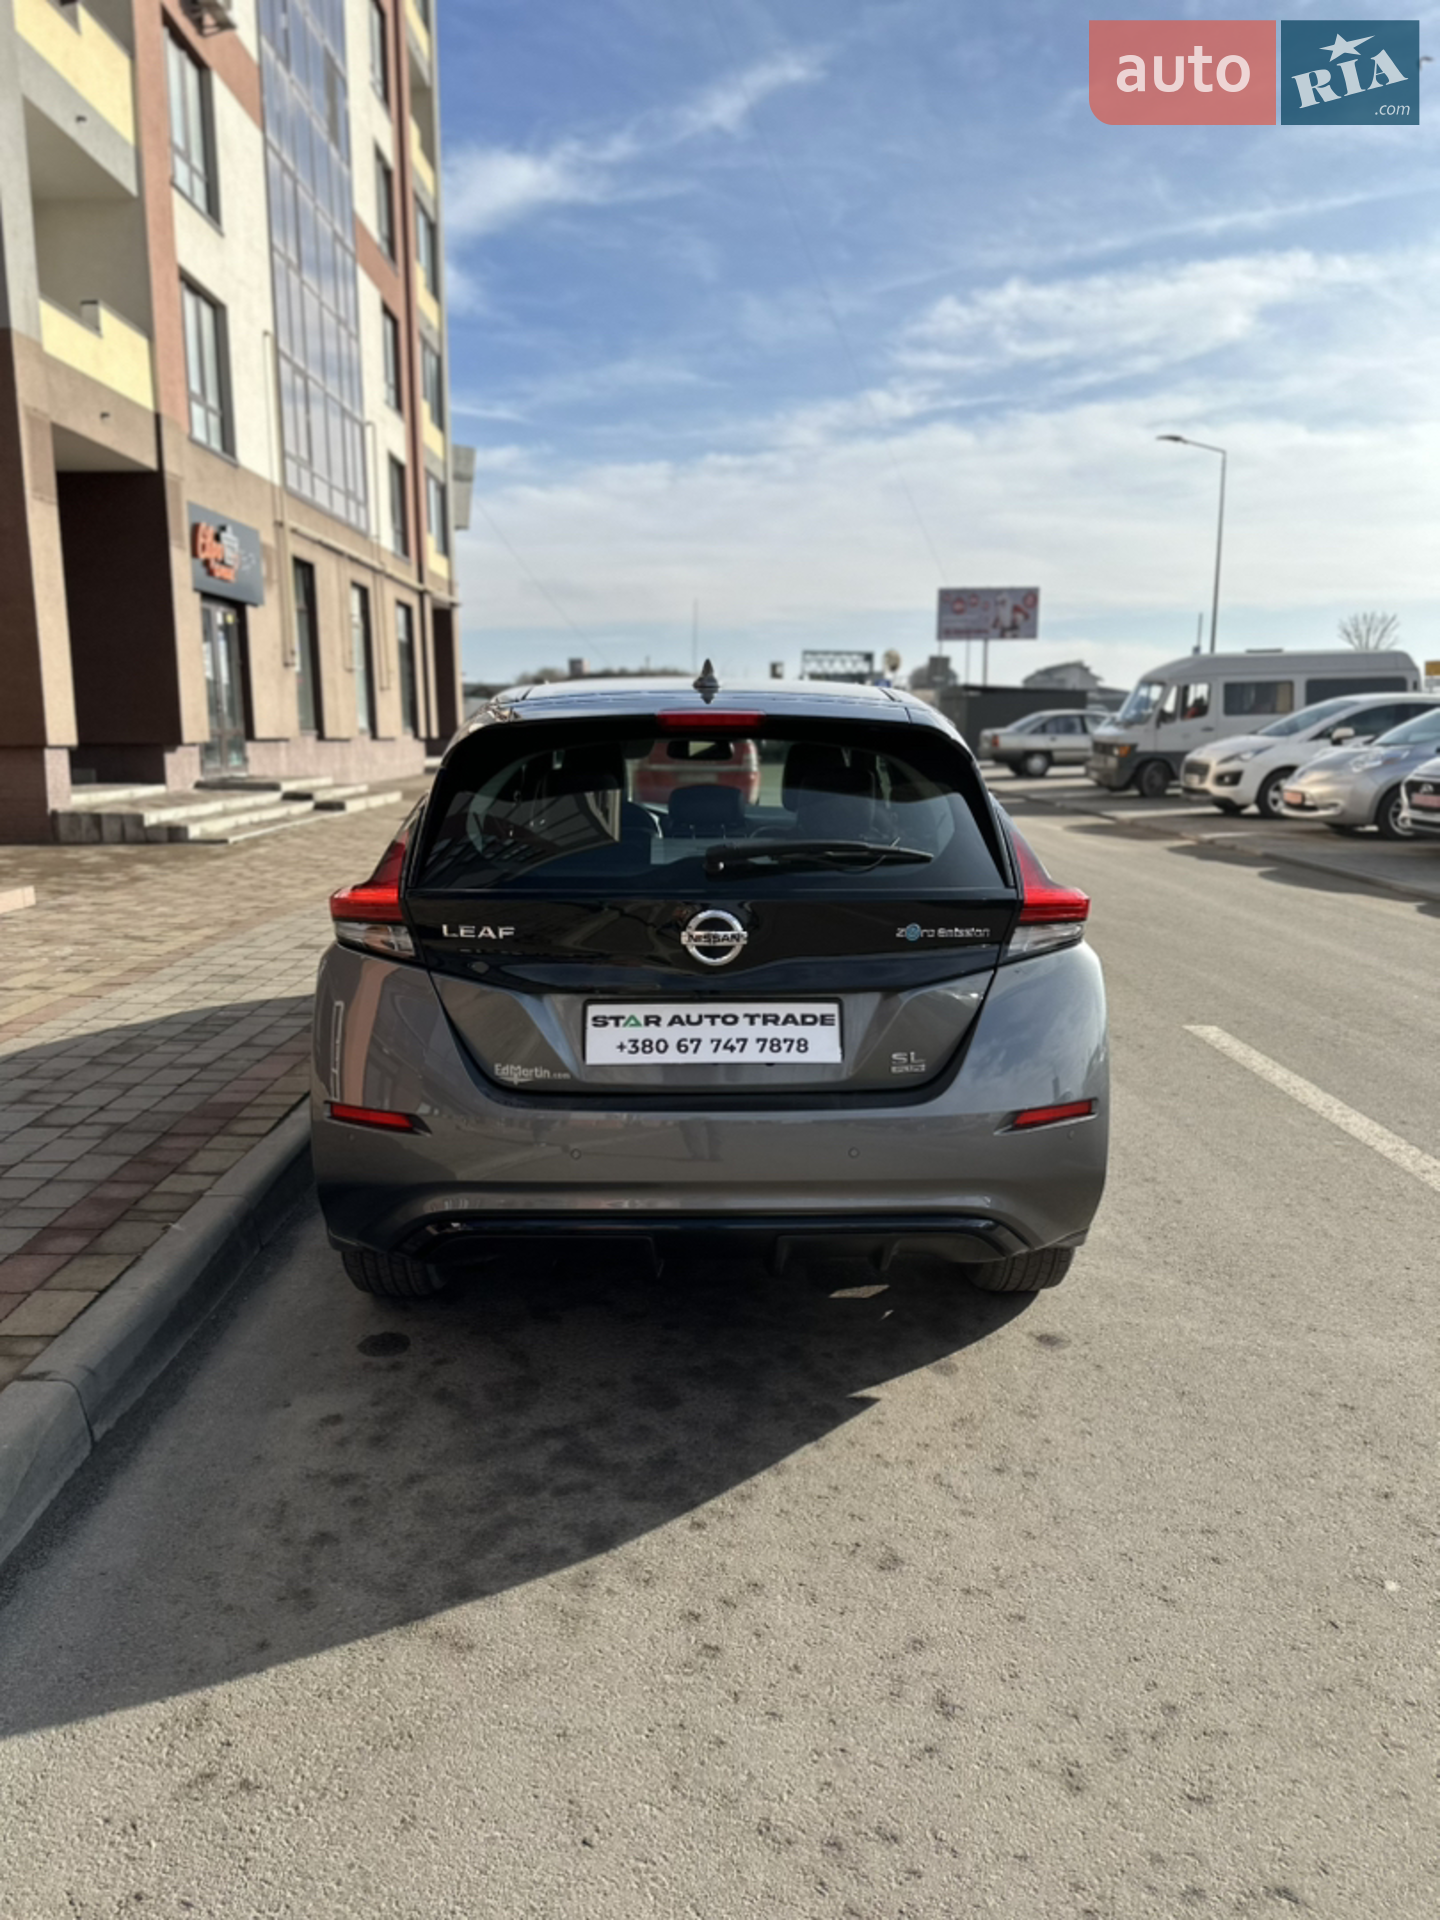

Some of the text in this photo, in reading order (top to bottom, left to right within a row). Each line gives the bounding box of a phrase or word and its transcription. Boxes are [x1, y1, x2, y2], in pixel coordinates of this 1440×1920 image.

[442, 924, 516, 939] LEAF
[687, 933, 741, 943] NISSAN
[591, 1013, 836, 1028] STAR AUTO TRADE
[616, 1037, 809, 1055] +380 67 747 7878
[891, 1052, 926, 1064] SL
